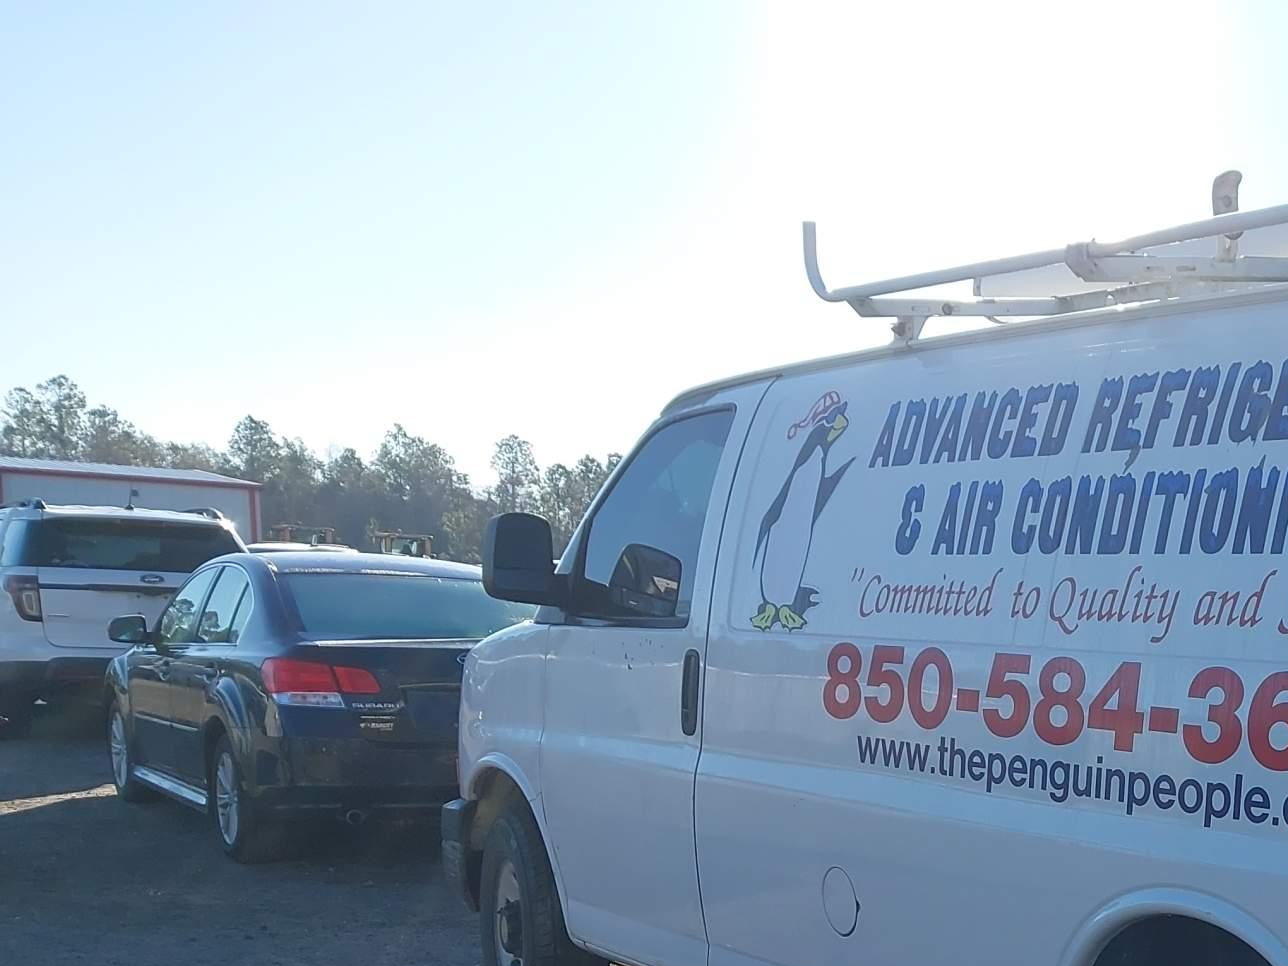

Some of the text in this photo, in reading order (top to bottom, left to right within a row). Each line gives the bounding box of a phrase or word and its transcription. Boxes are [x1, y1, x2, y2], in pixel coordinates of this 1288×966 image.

[867, 380, 1080, 469] ADVANCED
[895, 483, 926, 556] &
[930, 479, 1005, 556] AIR
[851, 567, 1004, 618] "Committed
[1010, 580, 1041, 619] to
[1049, 565, 1181, 644] Quality
[1193, 569, 1278, 629] and
